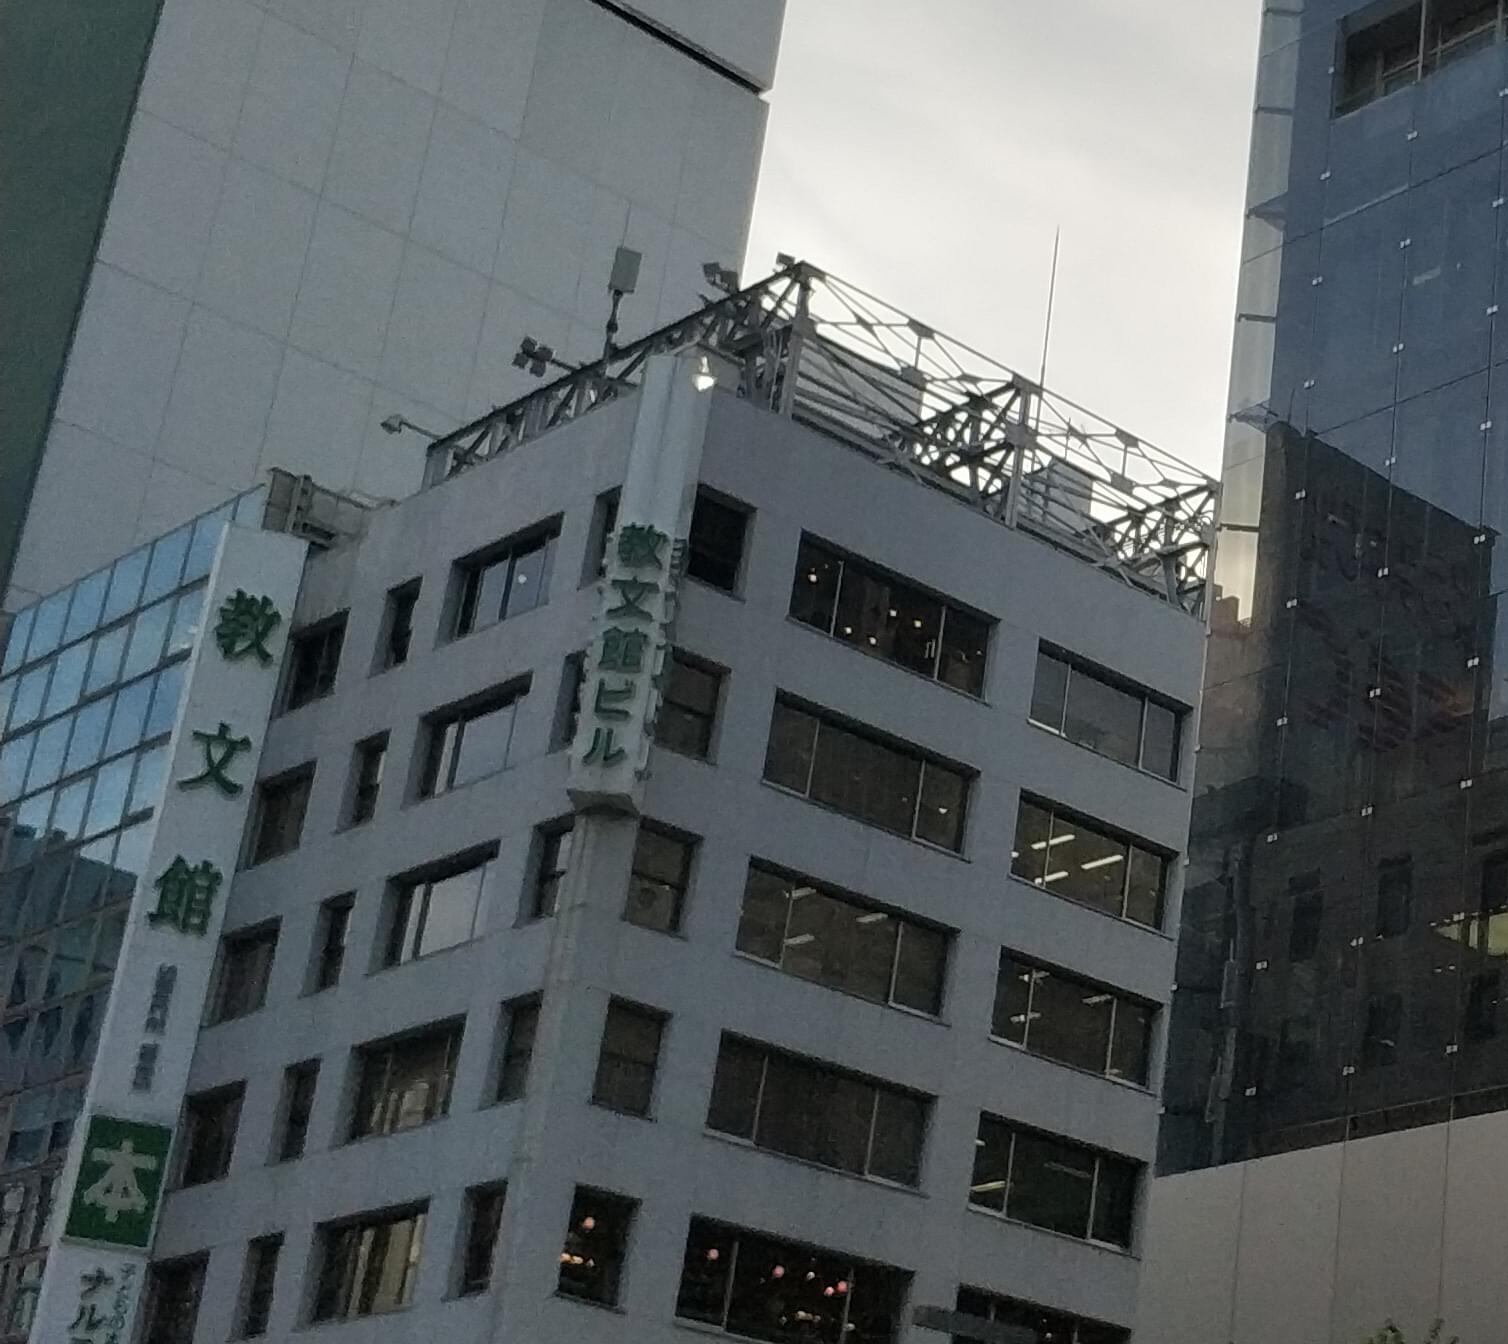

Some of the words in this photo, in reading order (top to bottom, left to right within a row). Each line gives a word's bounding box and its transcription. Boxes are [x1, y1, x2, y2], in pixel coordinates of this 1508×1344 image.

[148, 588, 283, 940] 教文館
[583, 521, 667, 766] 教文館ビル
[83, 1139, 158, 1223] 本
